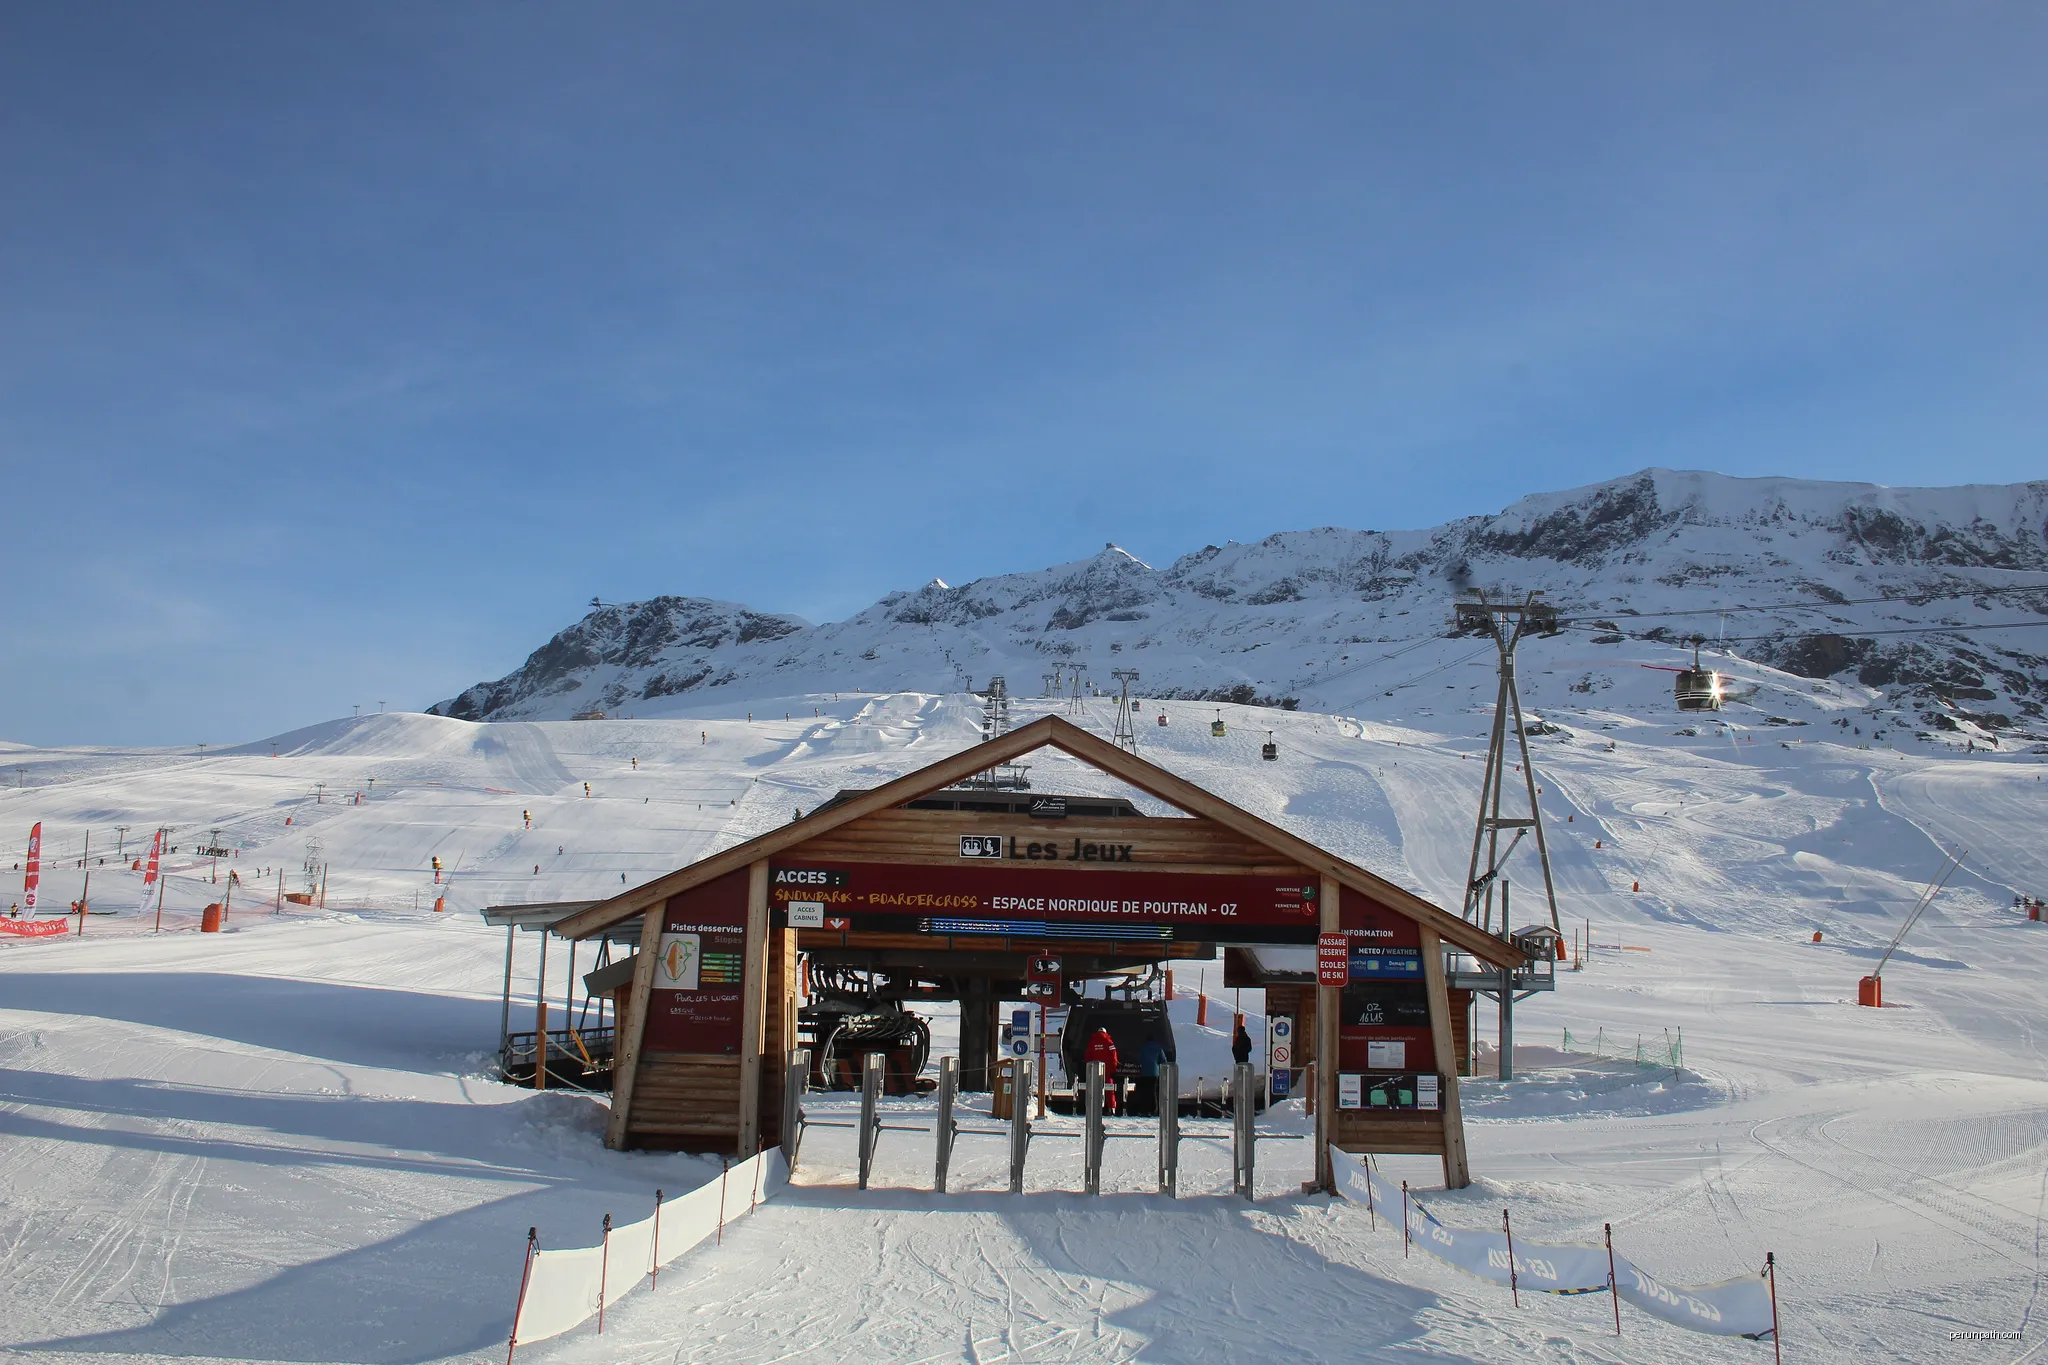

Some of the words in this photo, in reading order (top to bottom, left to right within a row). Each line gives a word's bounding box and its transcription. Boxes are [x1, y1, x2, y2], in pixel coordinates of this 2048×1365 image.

[1009, 836, 1057, 860] Les
[1066, 838, 1133, 862] Jeux
[776, 870, 827, 884] ACCES
[775, 889, 852, 903] SNOWPARK
[869, 893, 978, 908] BOARDERCROSS
[992, 896, 1045, 911] ESPACE
[1048, 898, 1118, 913] NORDIQUE
[1122, 901, 1139, 914] DE
[1143, 902, 1208, 915] POUTRAN
[1220, 903, 1238, 916] OZ
[671, 923, 696, 931] Pistes
[698, 924, 743, 933] desservies
[1341, 929, 1394, 938] INFORMATION
[714, 935, 742, 944] Slopes
[1320, 938, 1346, 946] PASSAGE
[1320, 948, 1346, 956] RESERVE
[1358, 947, 1381, 955] METEO
[1386, 948, 1417, 956] WEATHER
[1320, 961, 1346, 969] ECOLES
[1322, 971, 1331, 979] DE
[1332, 971, 1344, 979] SKI
[1366, 1003, 1382, 1011] OZ
